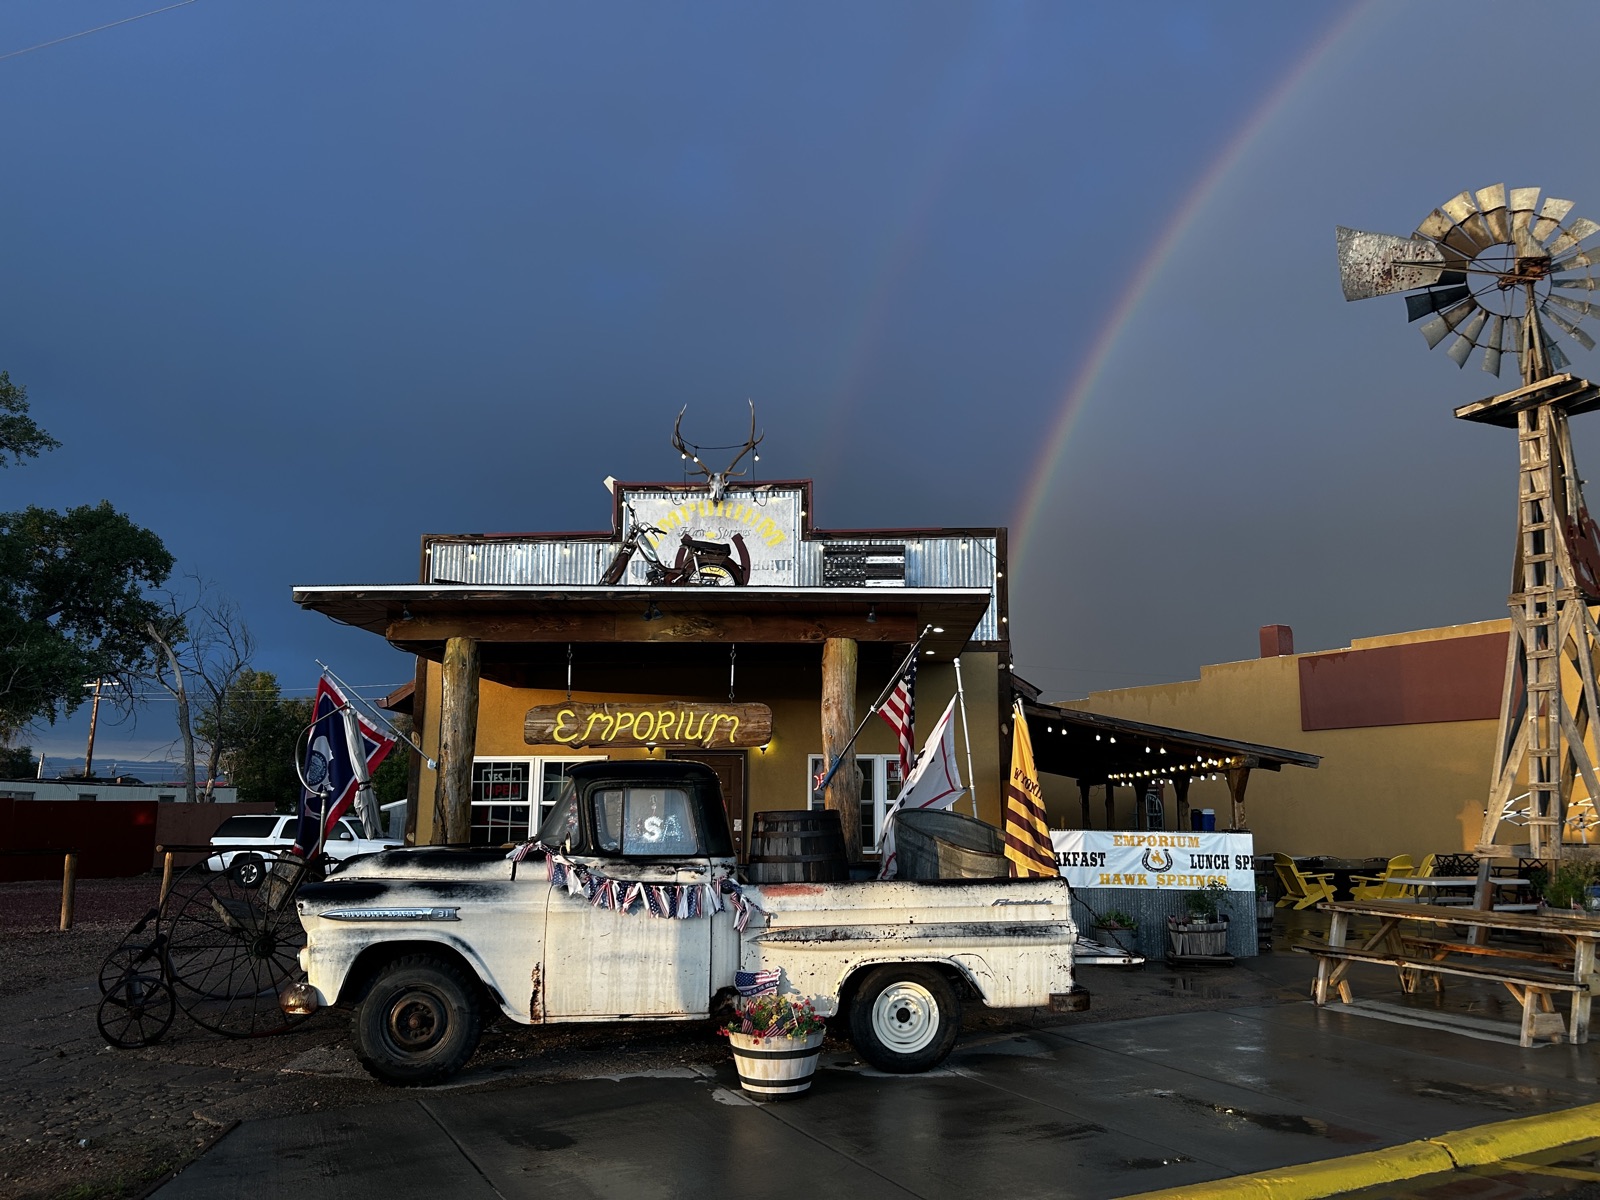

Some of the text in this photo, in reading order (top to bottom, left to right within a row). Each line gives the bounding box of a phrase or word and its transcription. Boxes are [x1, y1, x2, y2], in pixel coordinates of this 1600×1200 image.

[553, 709, 740, 743] EMPORIUM
[1113, 835, 1200, 848] EMPORIUM
[1052, 852, 1106, 867] AKFAST
[1189, 854, 1229, 870] LUNCH
[1099, 873, 1228, 888] HAWK SPRINGS
[438, 910, 449, 918] 31
